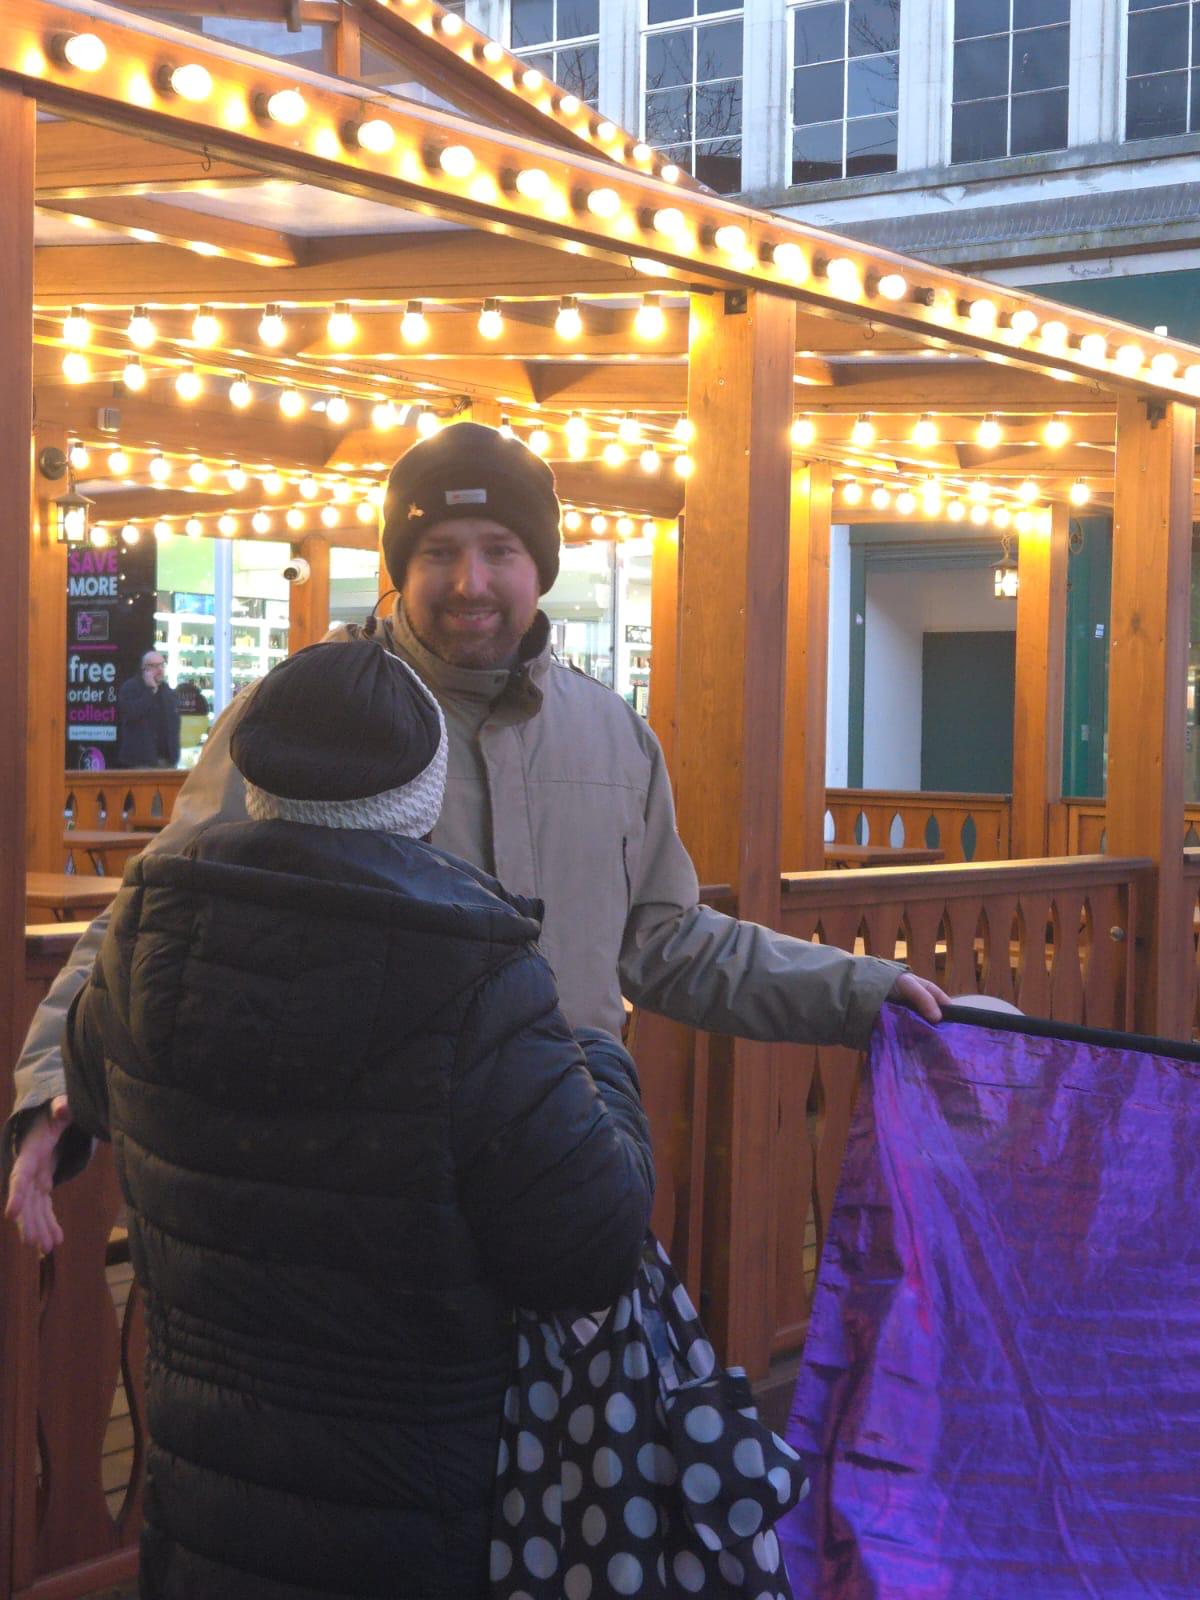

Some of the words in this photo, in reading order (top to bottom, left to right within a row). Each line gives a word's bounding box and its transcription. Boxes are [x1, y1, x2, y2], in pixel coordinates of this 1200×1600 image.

[69, 550, 118, 574] SAVE
[69, 576, 118, 597] MORE
[69, 655, 116, 682] free
[69, 686, 104, 702] order
[107, 686, 117, 702] &
[70, 704, 116, 722] collect
